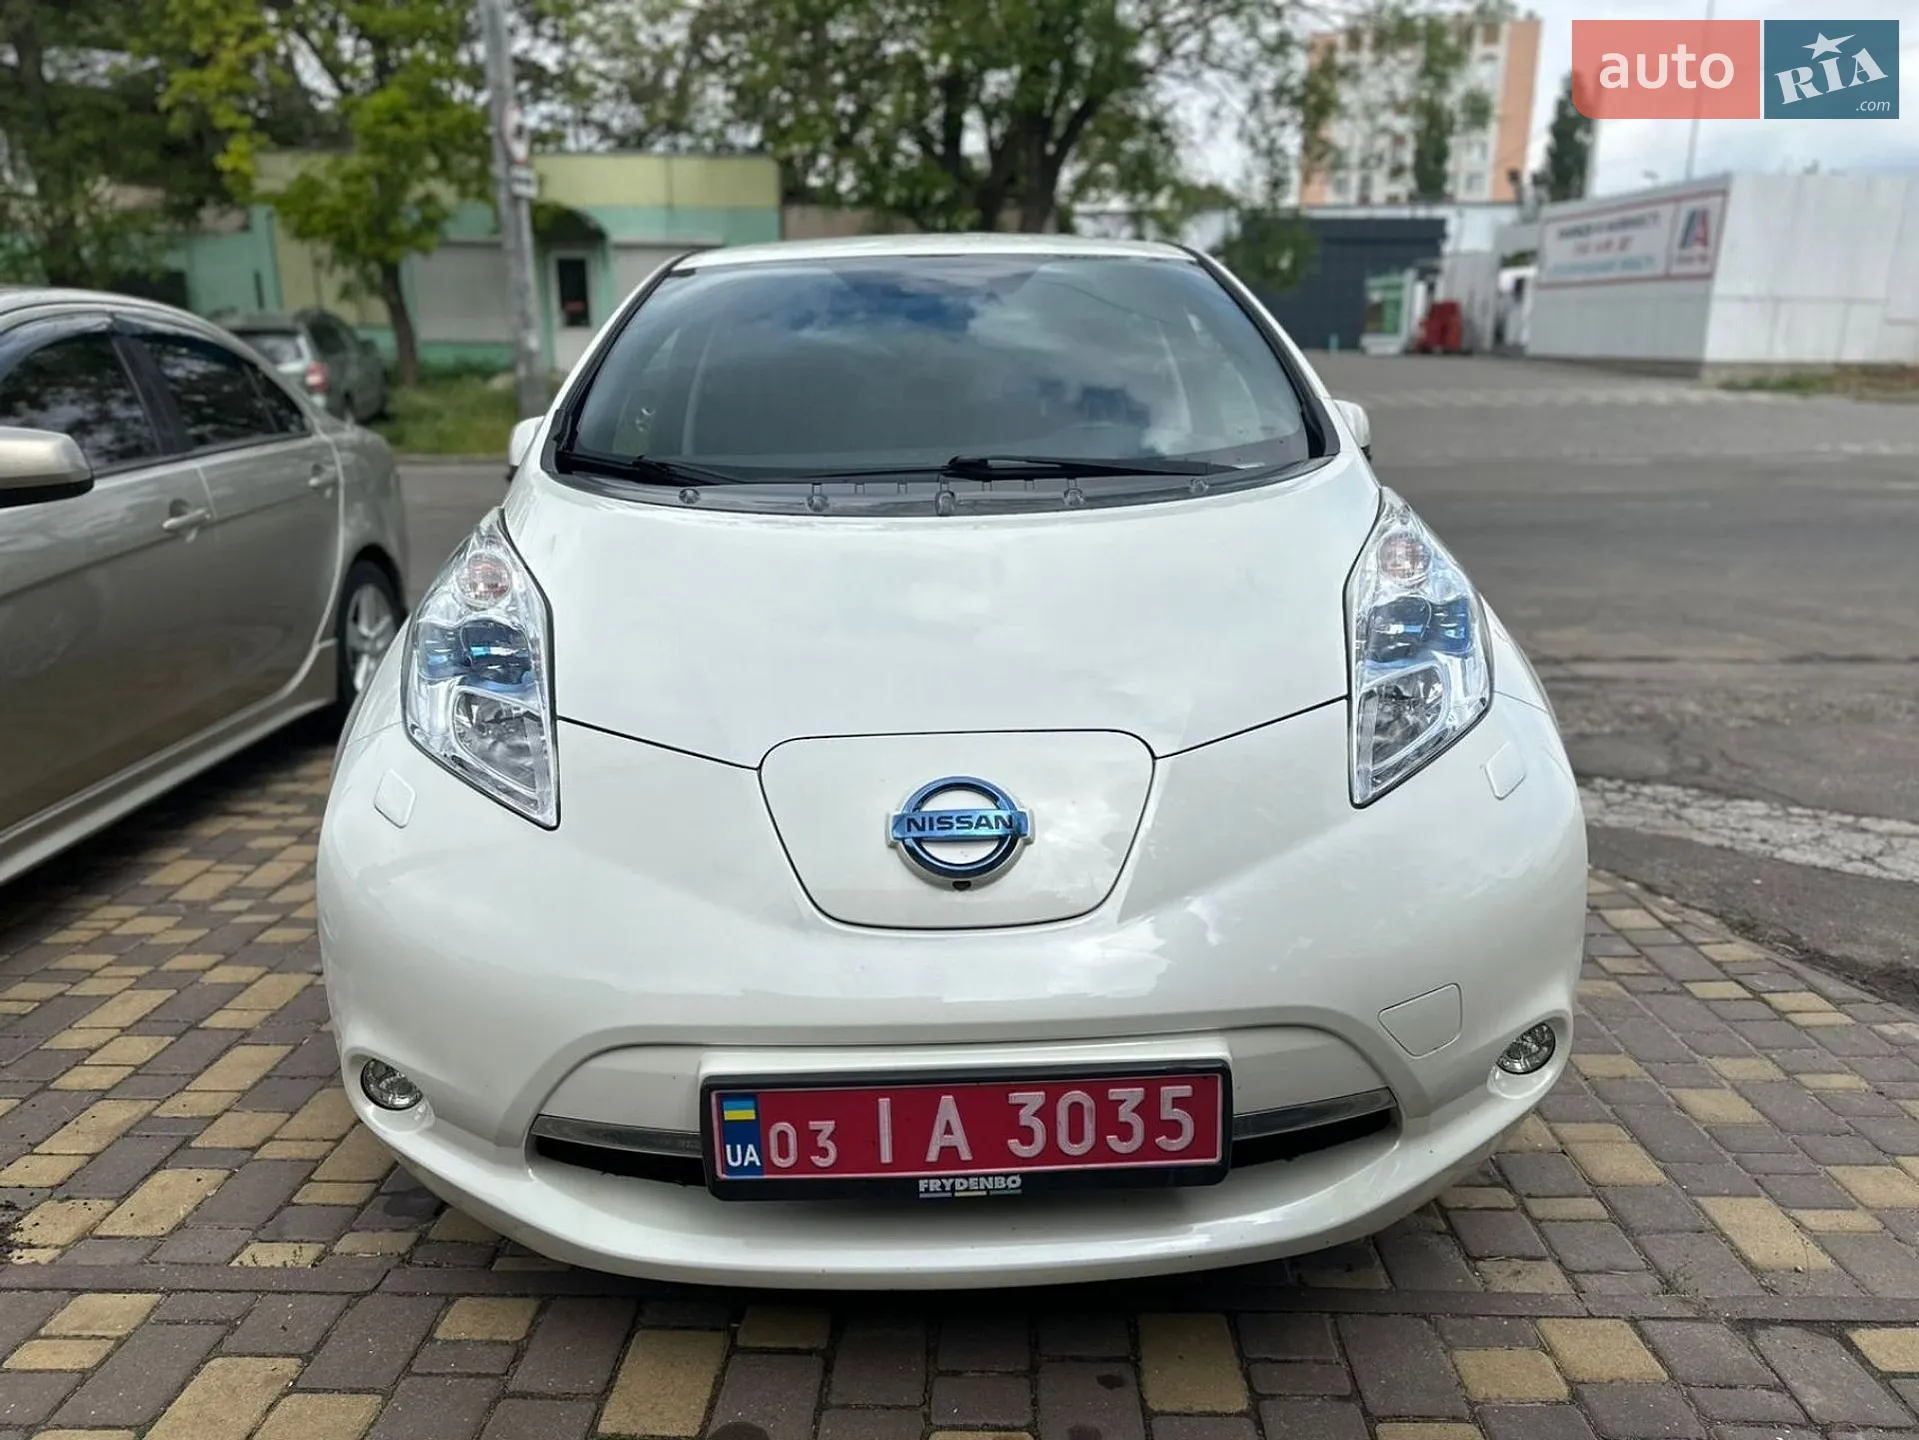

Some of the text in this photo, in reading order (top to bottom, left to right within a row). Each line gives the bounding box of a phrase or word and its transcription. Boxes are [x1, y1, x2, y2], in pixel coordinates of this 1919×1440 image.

[906, 814, 1014, 832] NISSAN
[768, 1120, 838, 1169] 03
[1007, 1085, 1195, 1159] 3035
[726, 1144, 761, 1167] UA
